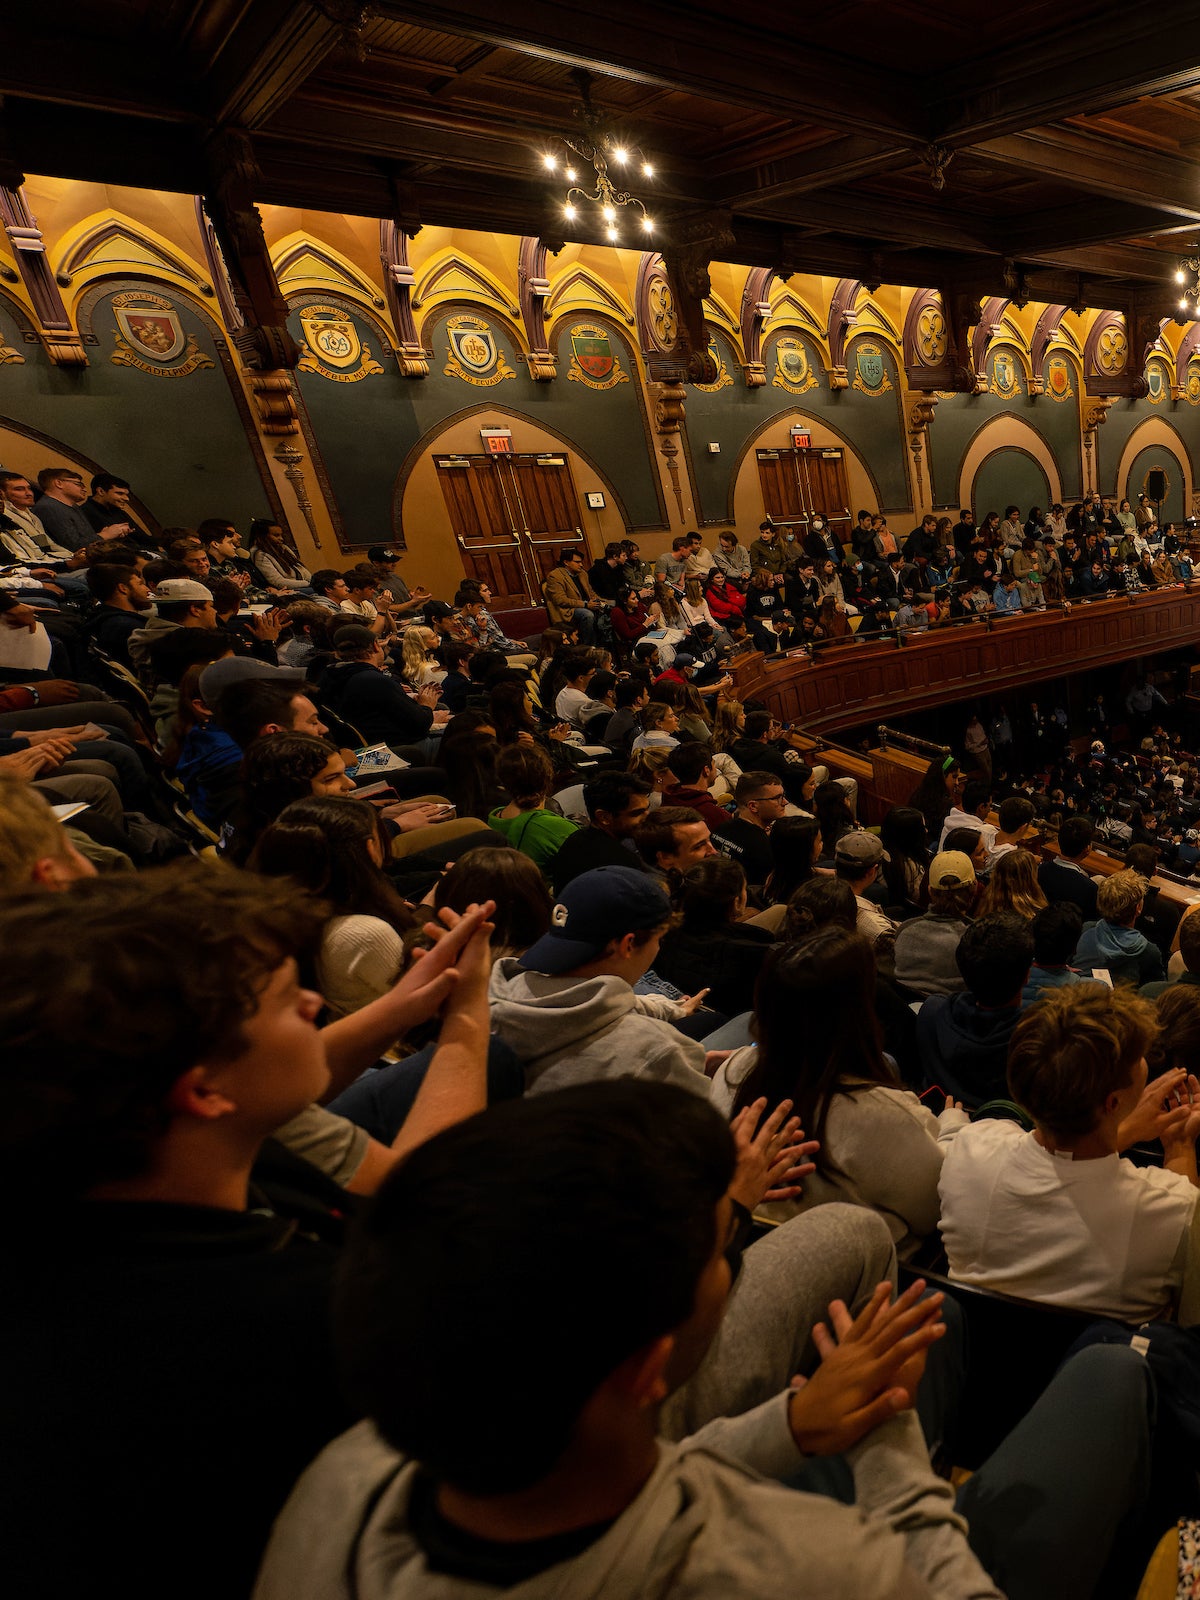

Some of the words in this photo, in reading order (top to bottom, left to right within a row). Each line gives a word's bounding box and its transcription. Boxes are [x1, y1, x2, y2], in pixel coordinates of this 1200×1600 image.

[124, 353, 192, 377] PHILADELPHIA
[488, 438, 510, 452] EXIT
[795, 435, 809, 447] EXIT
[552, 904, 568, 927] G
